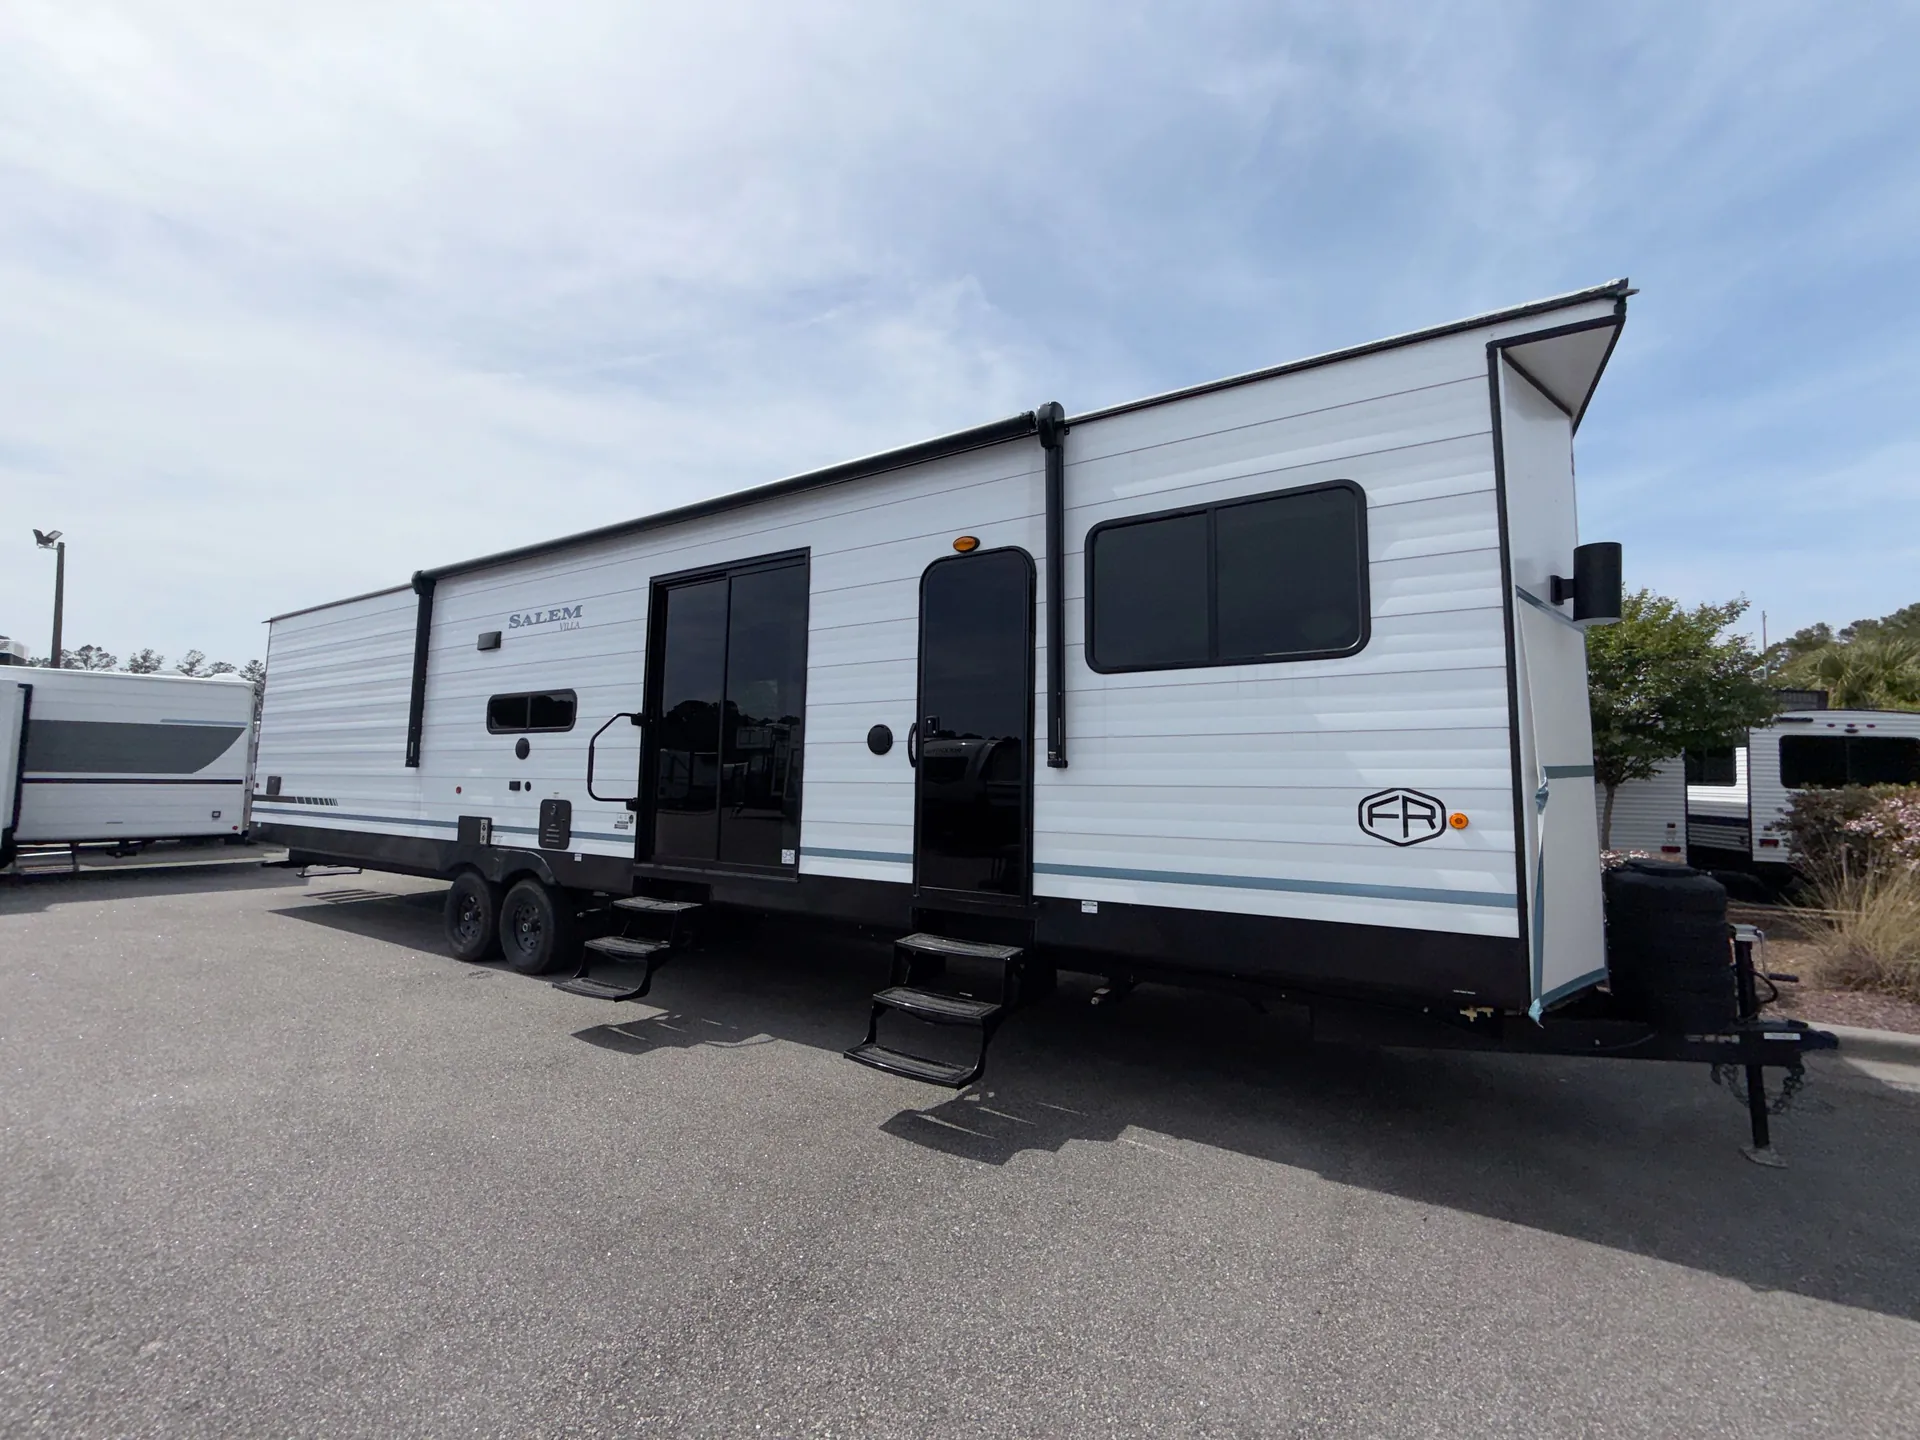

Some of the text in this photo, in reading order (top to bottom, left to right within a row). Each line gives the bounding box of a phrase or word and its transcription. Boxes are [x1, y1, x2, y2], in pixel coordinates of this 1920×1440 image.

[509, 605, 583, 629] SALEM
[560, 621, 581, 632] VILLA
[1367, 795, 1437, 838] FR
